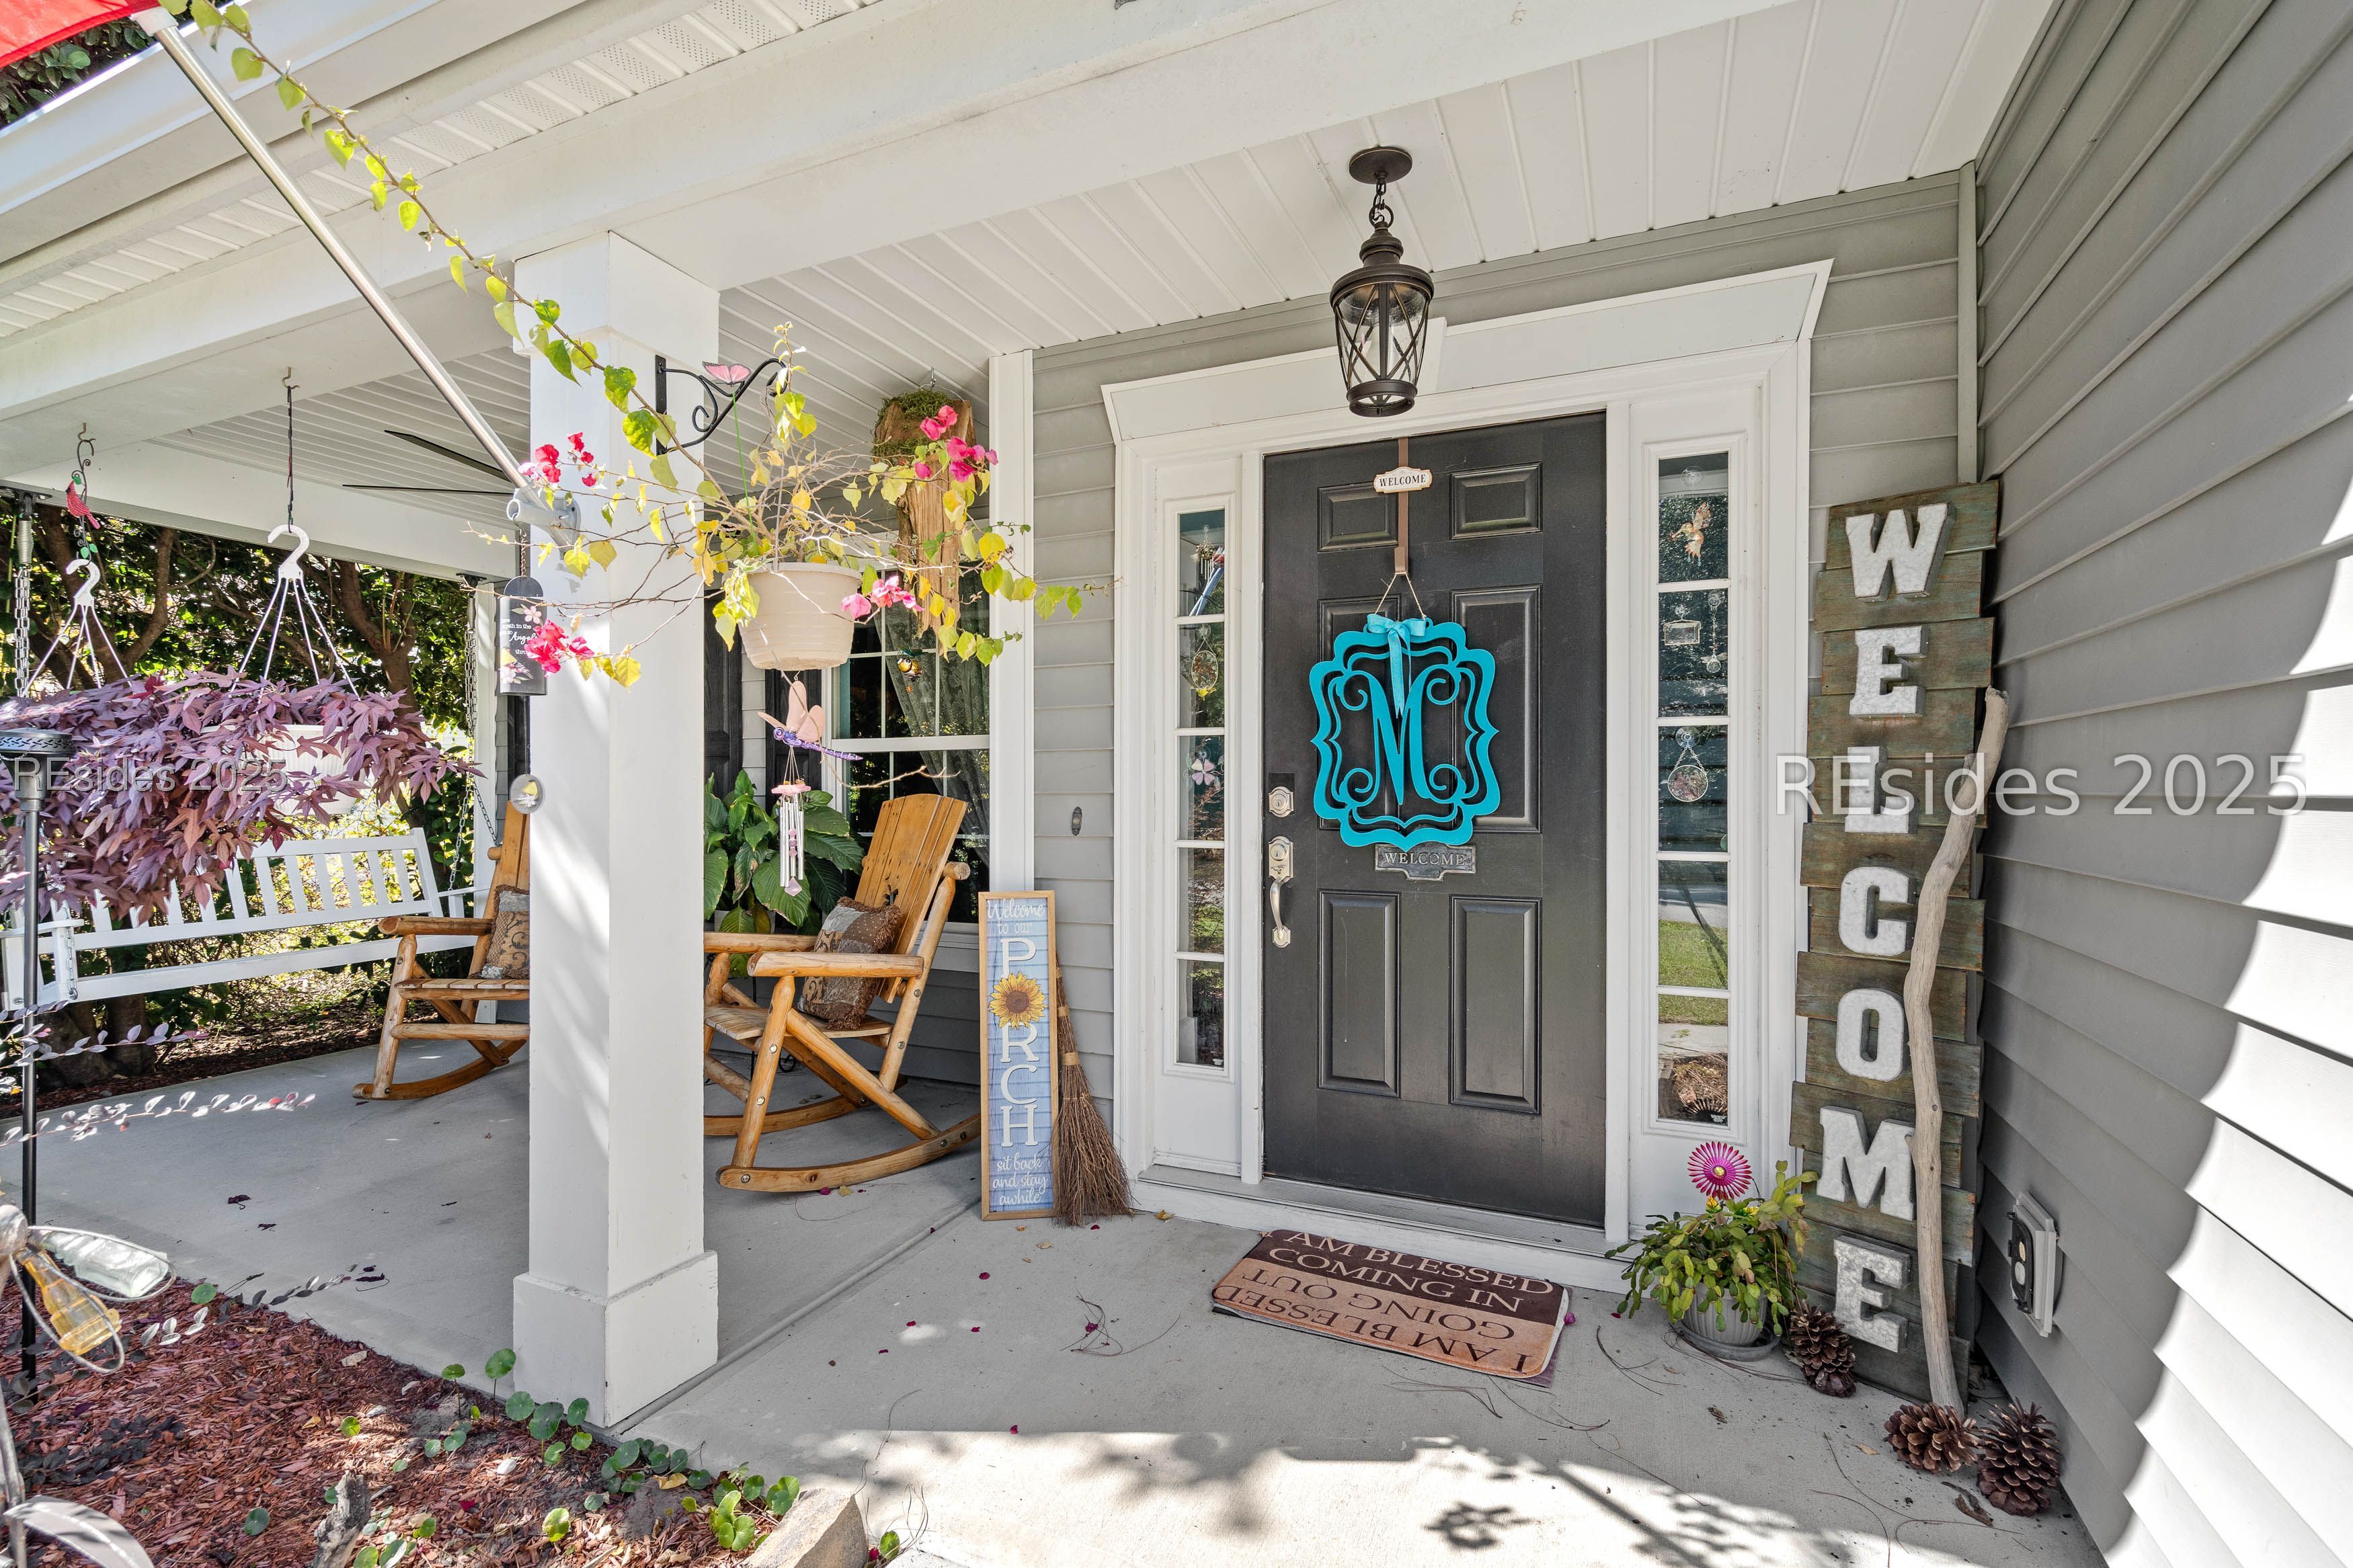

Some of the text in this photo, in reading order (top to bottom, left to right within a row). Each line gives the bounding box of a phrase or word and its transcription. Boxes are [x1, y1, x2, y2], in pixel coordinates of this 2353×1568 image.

[1380, 474, 1426, 487] WELCOME
[1339, 663, 1462, 805] M
[1384, 852, 1465, 866] WELCOME
[987, 898, 1045, 920] Welcome
[997, 919, 1033, 934] to our
[1814, 502, 1956, 1353] WELCOME
[996, 1153, 1043, 1171] sit back
[993, 1171, 1048, 1194] and stay
[999, 1188, 1041, 1206] awhile
[1283, 1232, 1554, 1295] AM BLESSED
[1269, 1247, 1525, 1313] COMING IN
[1213, 1284, 1398, 1342] BLESSED
[1242, 1268, 1515, 1340] GOING OUT
[1408, 1330, 1502, 1363] AM
